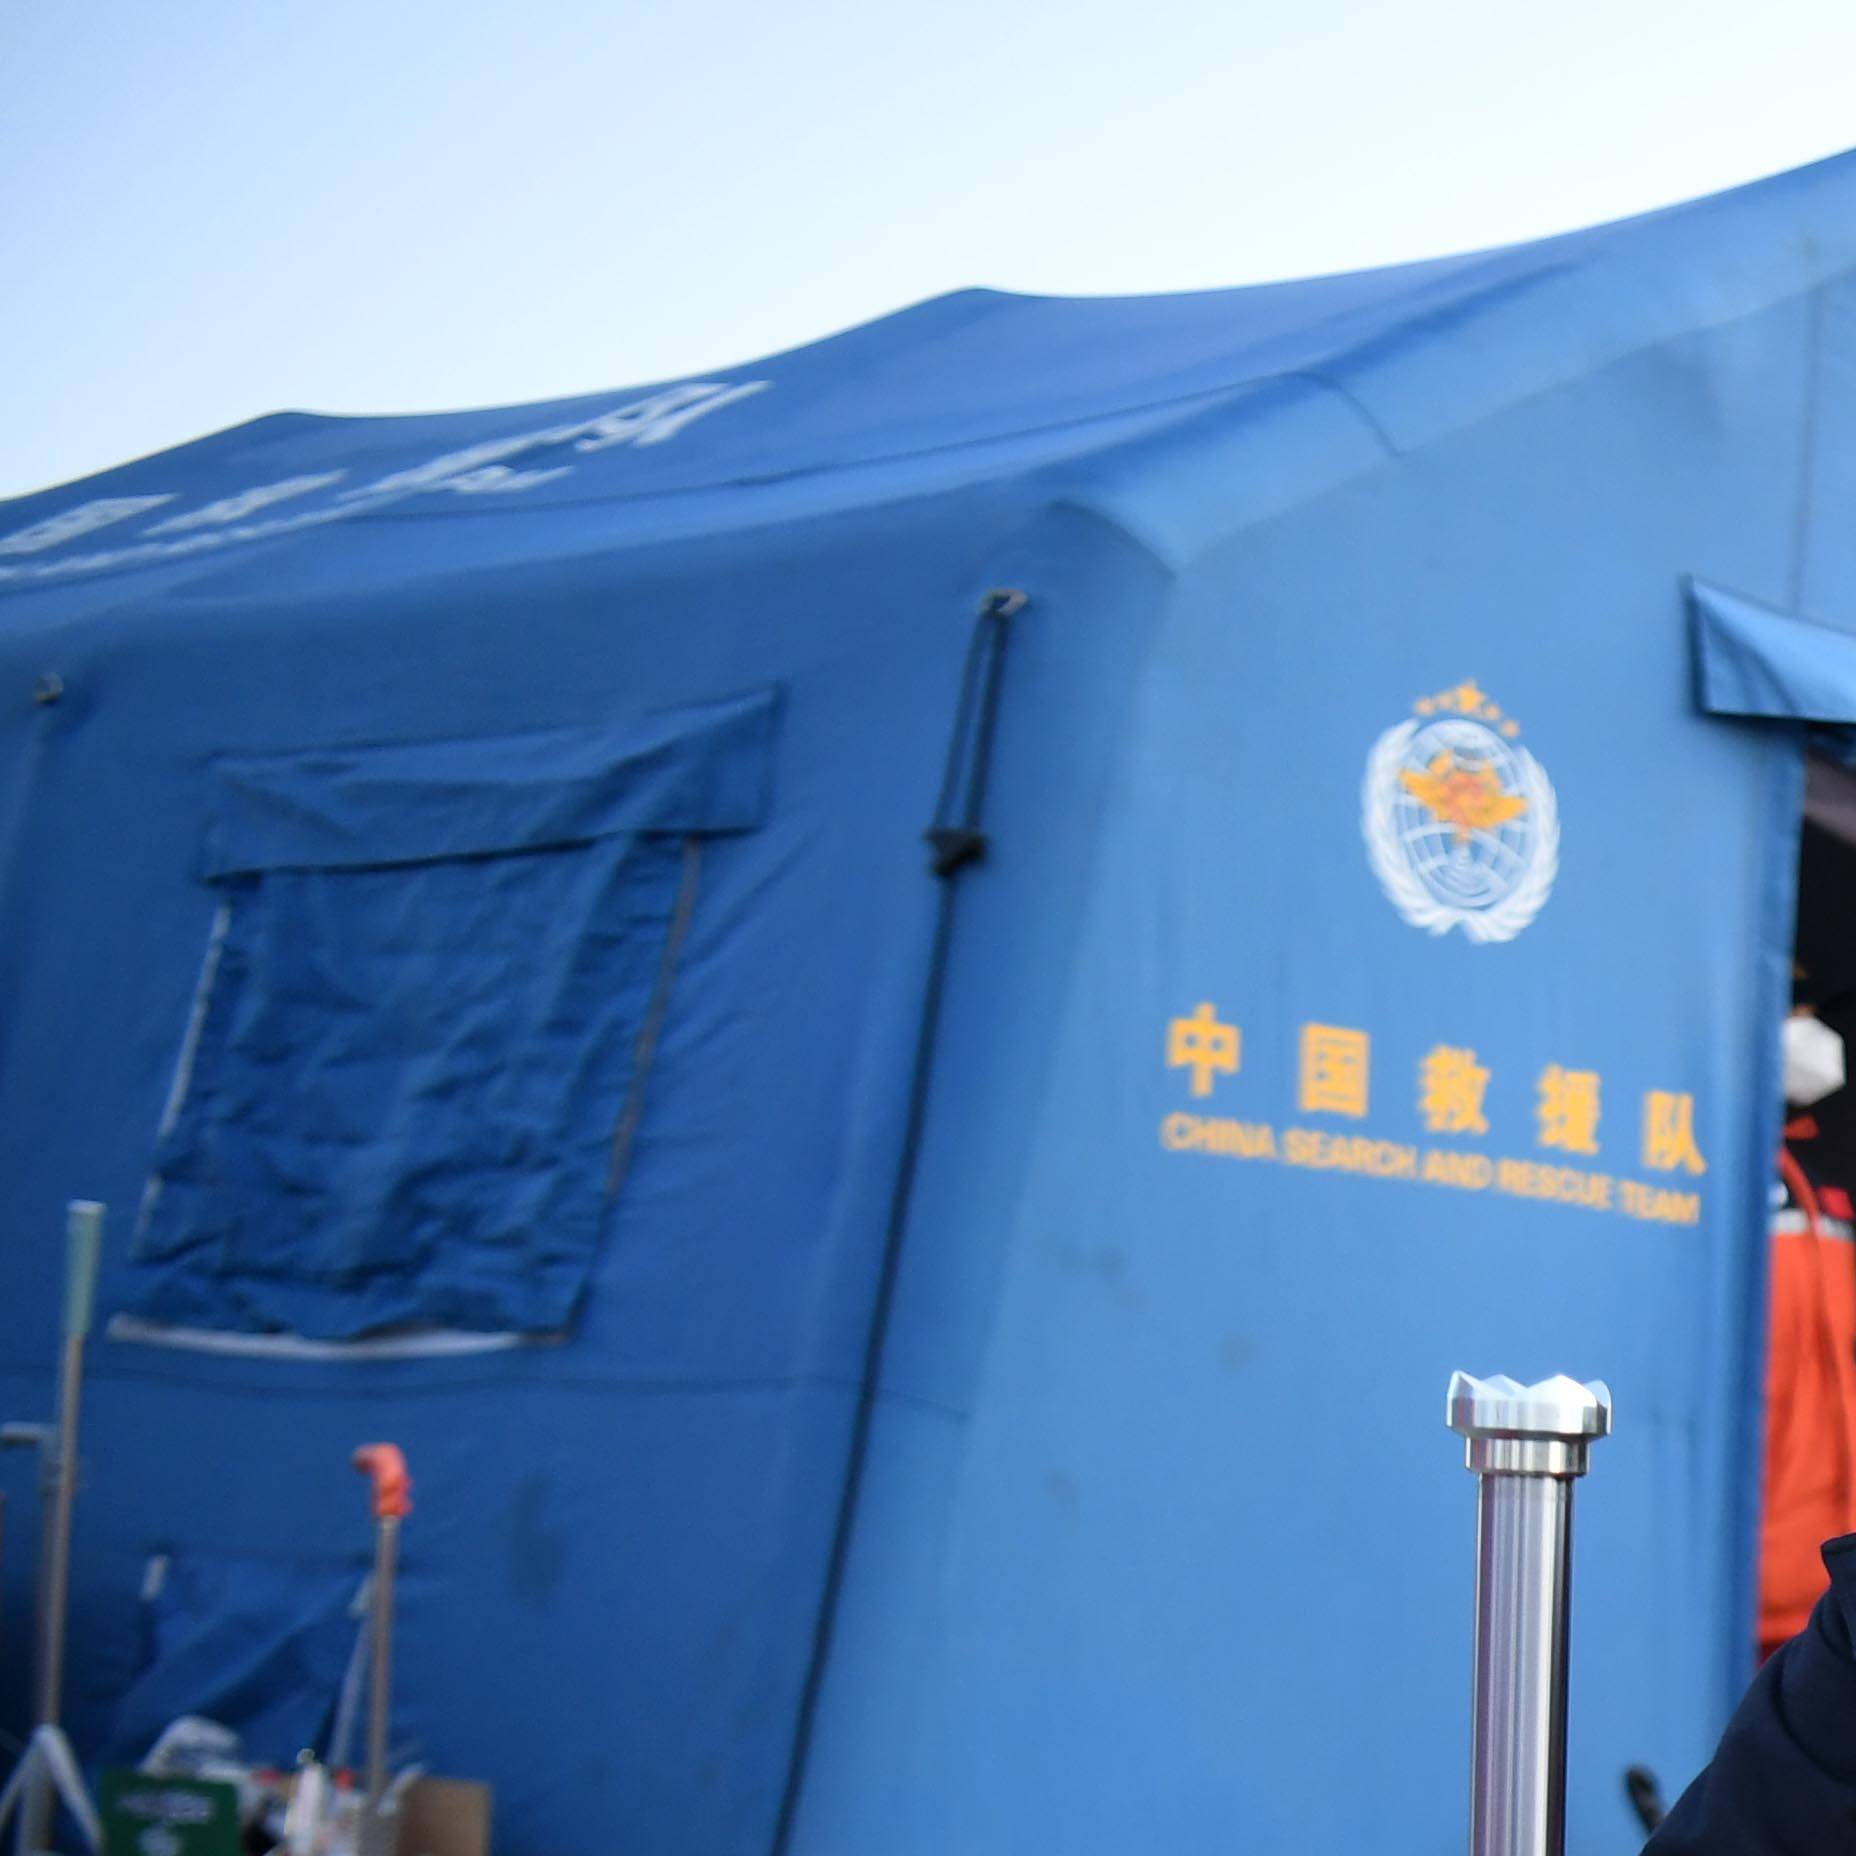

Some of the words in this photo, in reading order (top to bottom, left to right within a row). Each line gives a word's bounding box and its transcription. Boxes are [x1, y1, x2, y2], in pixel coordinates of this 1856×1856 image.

[1167, 1001, 1707, 1176] 中国救援队
[1161, 1111, 1277, 1160] CHINA
[1283, 1128, 1418, 1179] SEARCH
[1421, 1149, 1493, 1190] AND
[1496, 1157, 1614, 1212] RESCUE
[1616, 1179, 1701, 1226] TEAM
